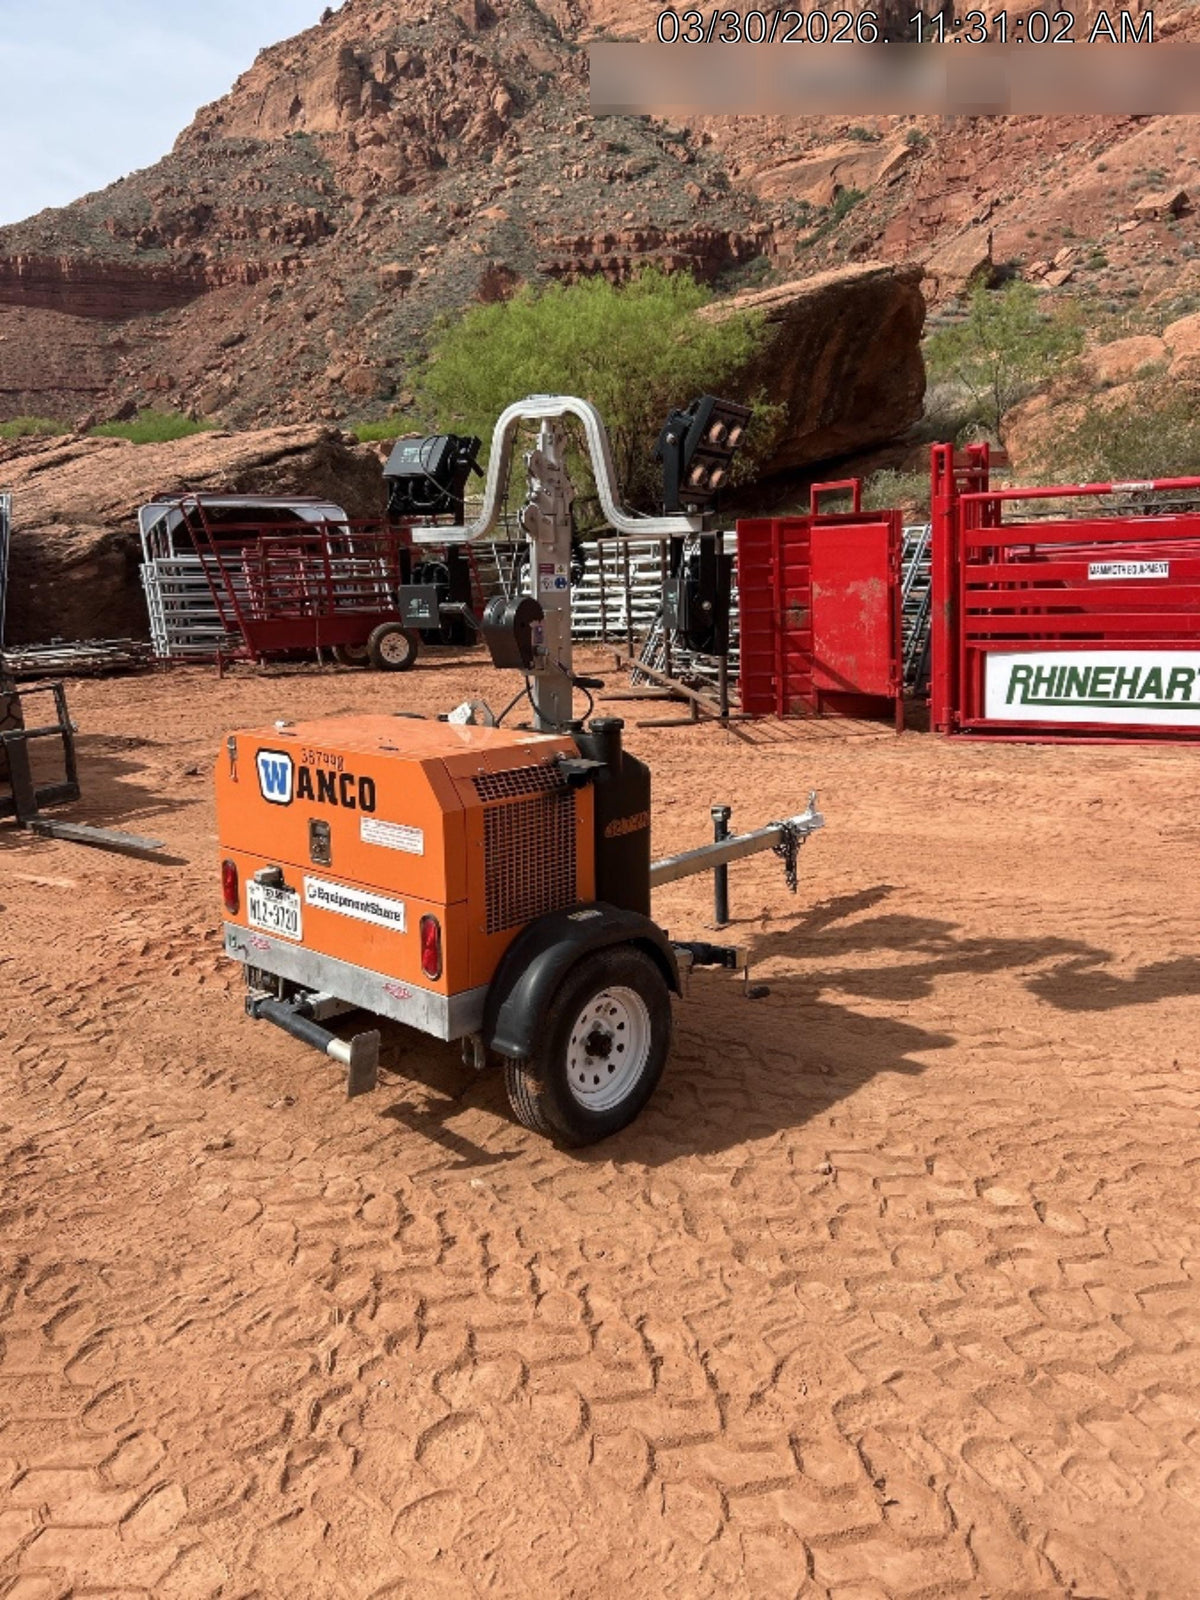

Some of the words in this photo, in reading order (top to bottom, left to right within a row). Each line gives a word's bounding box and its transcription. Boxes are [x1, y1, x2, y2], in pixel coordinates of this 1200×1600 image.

[1005, 664, 1200, 706] RHINEHAR
[259, 756, 376, 813] WANCO
[317, 886, 401, 922] EquipmentShare
